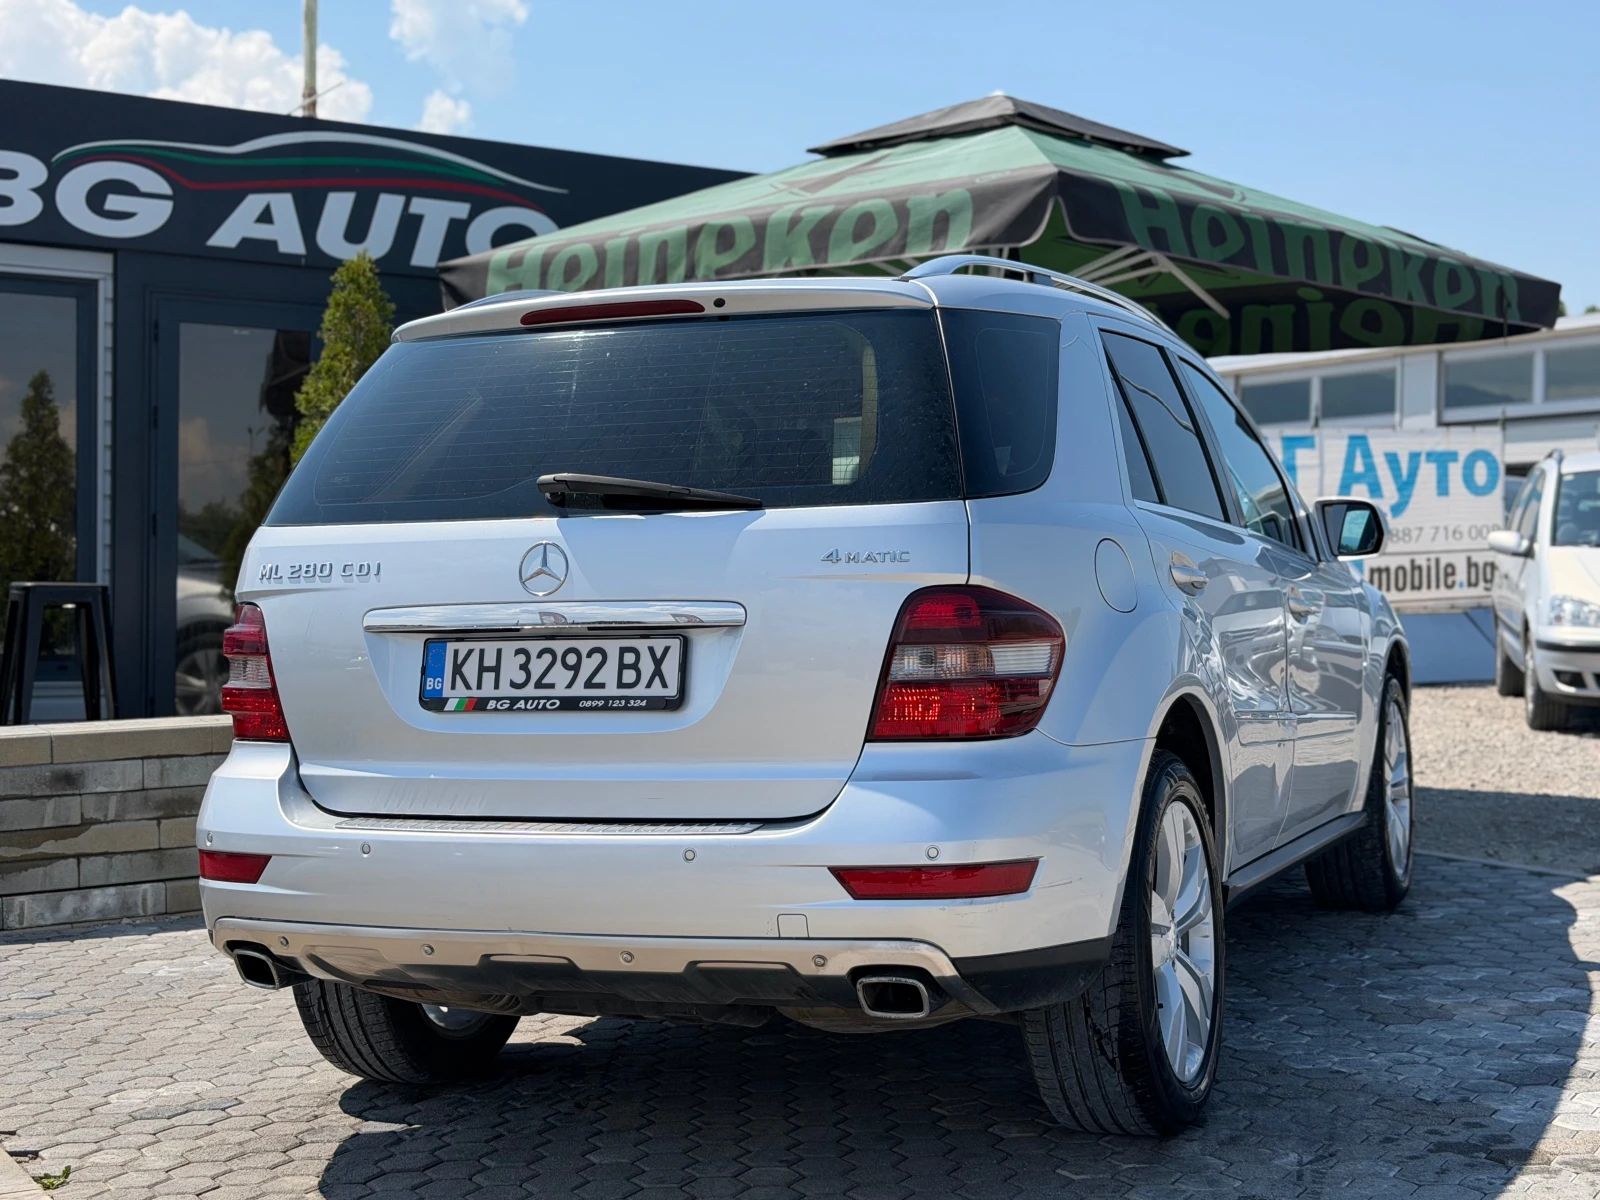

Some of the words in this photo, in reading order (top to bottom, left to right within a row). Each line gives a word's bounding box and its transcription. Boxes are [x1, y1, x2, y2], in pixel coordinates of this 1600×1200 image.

[206, 190, 560, 268] AUTO
[486, 188, 972, 297] Heineken
[1116, 181, 1521, 322] Heineken
[1336, 434, 1500, 519] Ауто
[1430, 524, 1464, 542] 716
[259, 564, 283, 580] ML
[287, 562, 333, 579] 280
[340, 561, 381, 577] CDI
[1369, 556, 1499, 593] mobile.bg
[426, 677, 442, 690] BG
[486, 699, 511, 710] BG
[513, 699, 560, 710] AUTO
[579, 700, 605, 708] 0899
